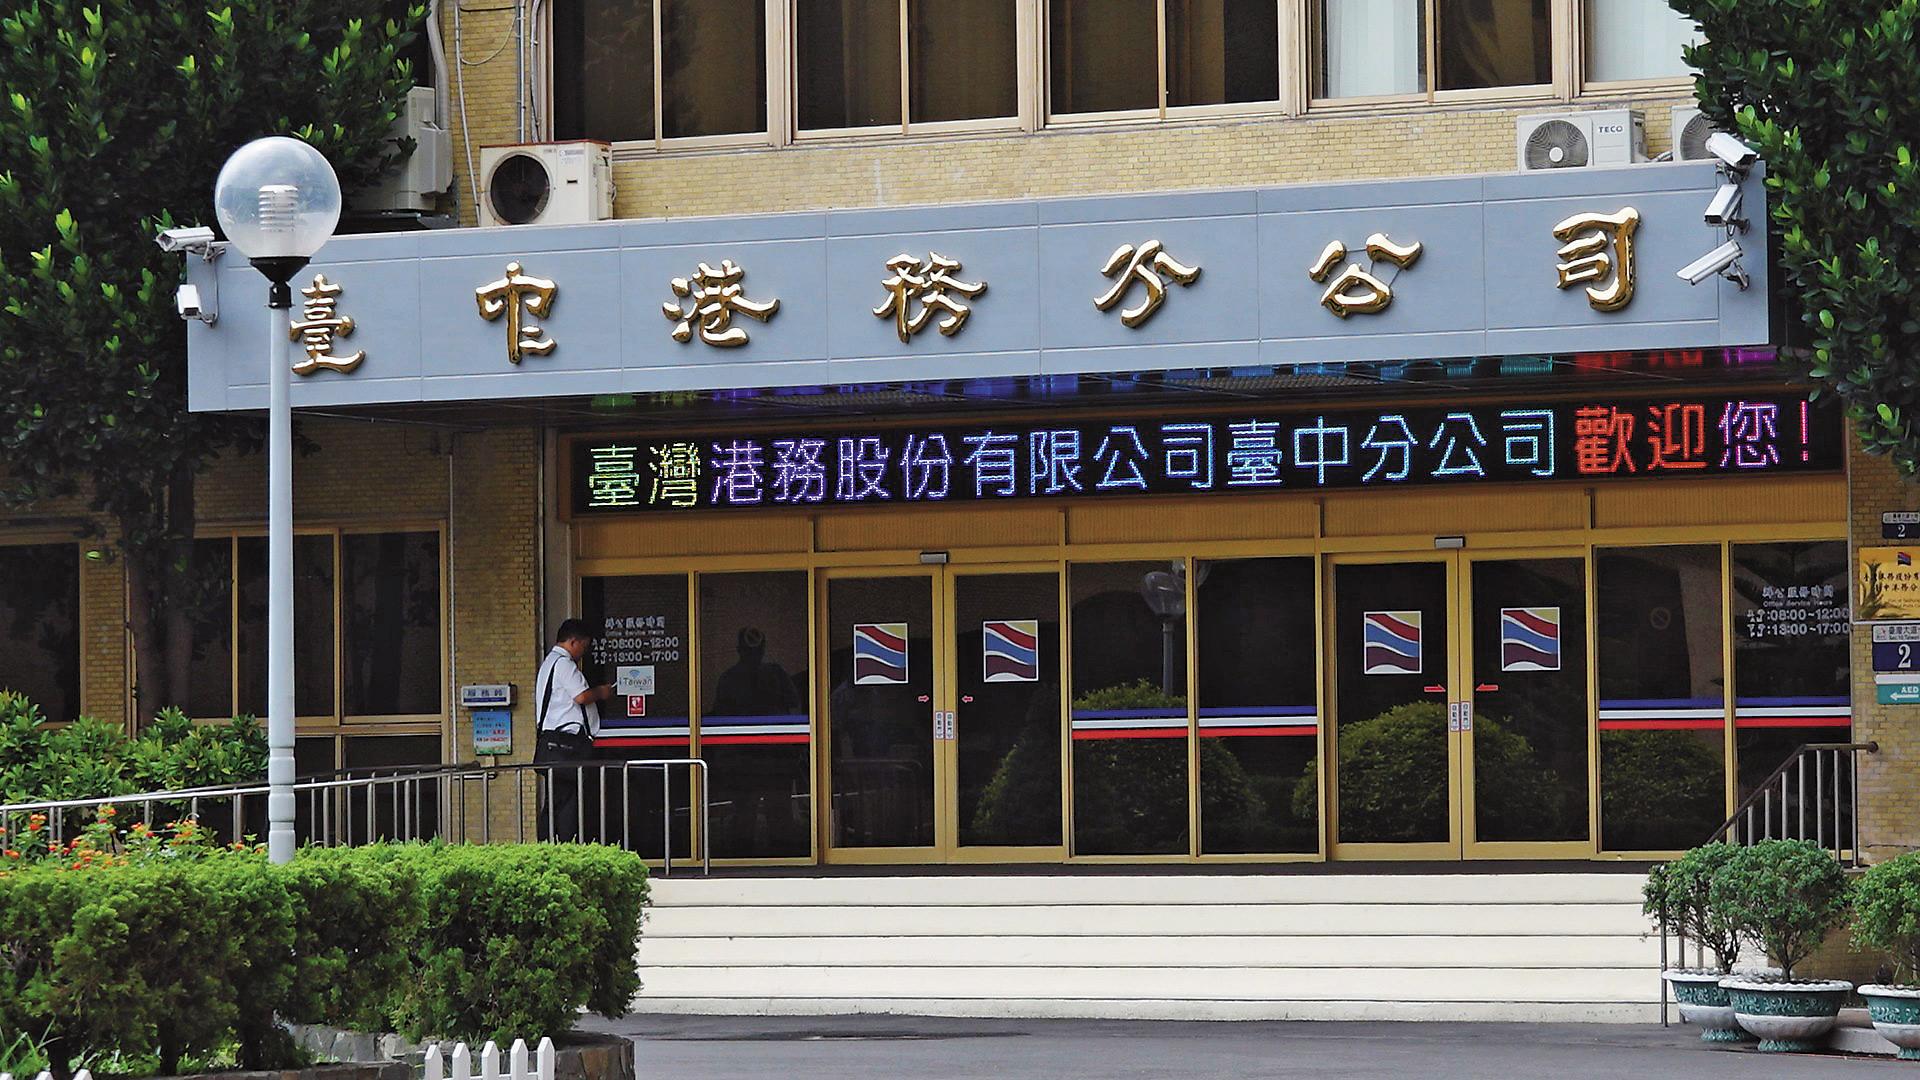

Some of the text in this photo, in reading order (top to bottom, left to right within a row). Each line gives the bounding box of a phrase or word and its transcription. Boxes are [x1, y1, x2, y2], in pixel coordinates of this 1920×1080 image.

[1598, 125, 1623, 133] TECO
[1897, 523, 1906, 538] 2
[1897, 643, 1912, 669] 2
[1901, 686, 1919, 694] AED
